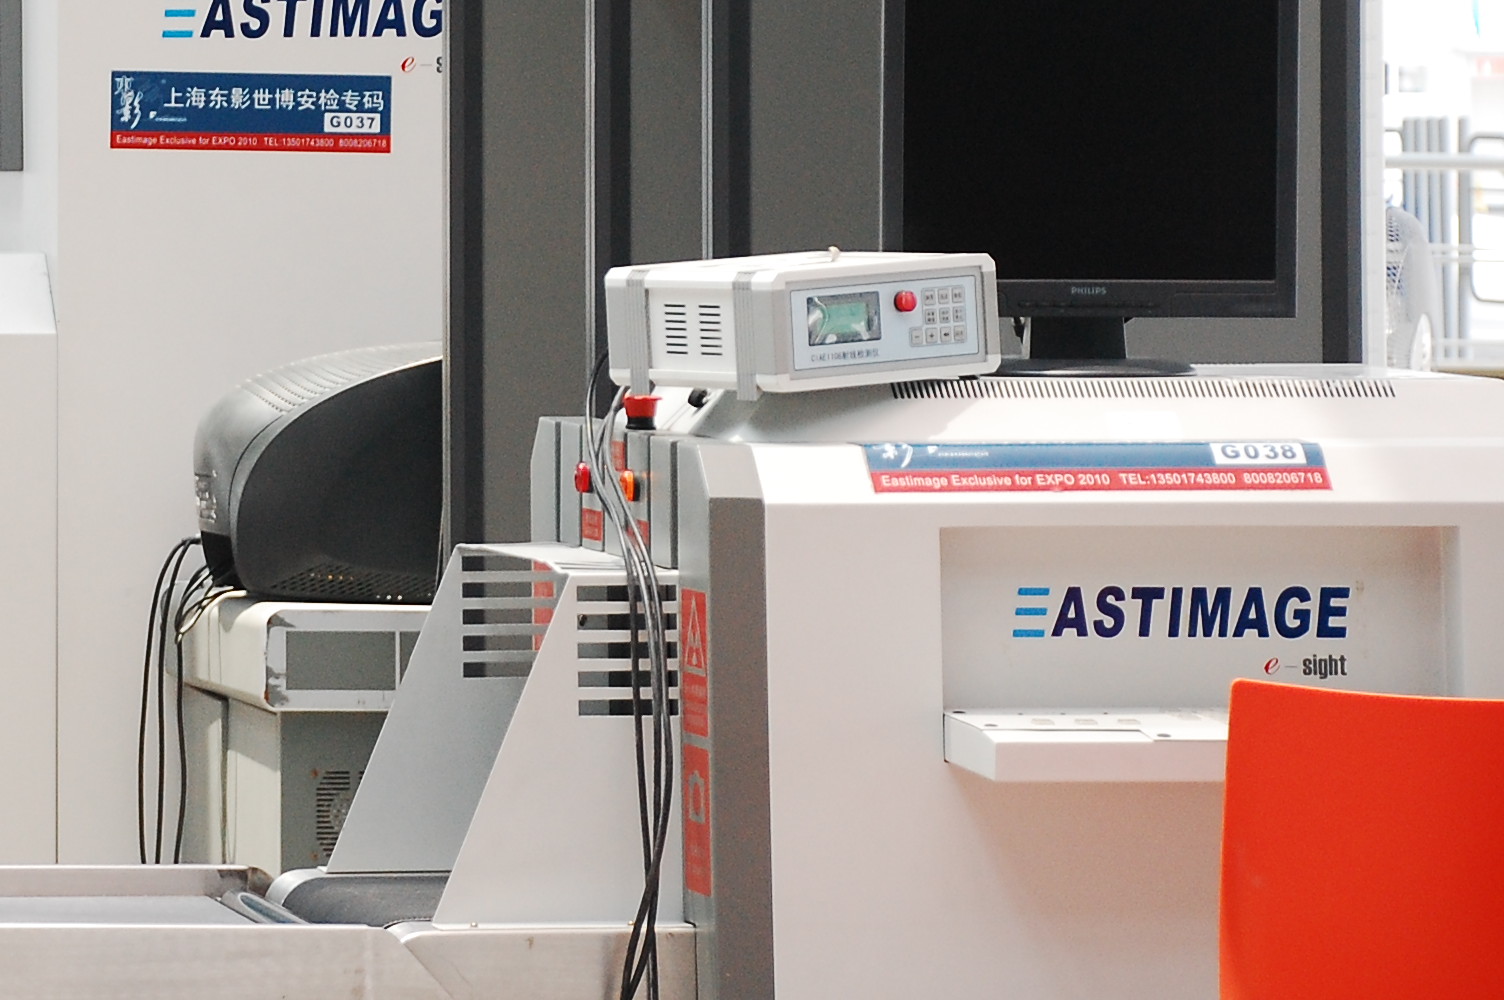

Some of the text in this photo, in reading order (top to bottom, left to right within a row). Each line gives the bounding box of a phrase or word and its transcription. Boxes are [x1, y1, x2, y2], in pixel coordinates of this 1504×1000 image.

[163, 86, 384, 111] 上海东影世博安检专码
[330, 115, 375, 129] G037
[116, 134, 157, 146] Eastimage
[160, 135, 196, 145] Exclusive
[199, 136, 209, 145] for
[212, 136, 236, 145] EXPO
[238, 137, 258, 146] 2010
[1071, 286, 1107, 295] PHILIPS
[1220, 444, 1298, 460] G038
[881, 474, 948, 488] Eastimage
[951, 474, 1012, 487] Exclusive
[1015, 474, 1034, 486] for
[1037, 474, 1074, 486] EXPO
[1079, 473, 1110, 486] 2010
[1243, 472, 1323, 484] 8008206718
[1012, 586, 1351, 639] EASTIMAGE
